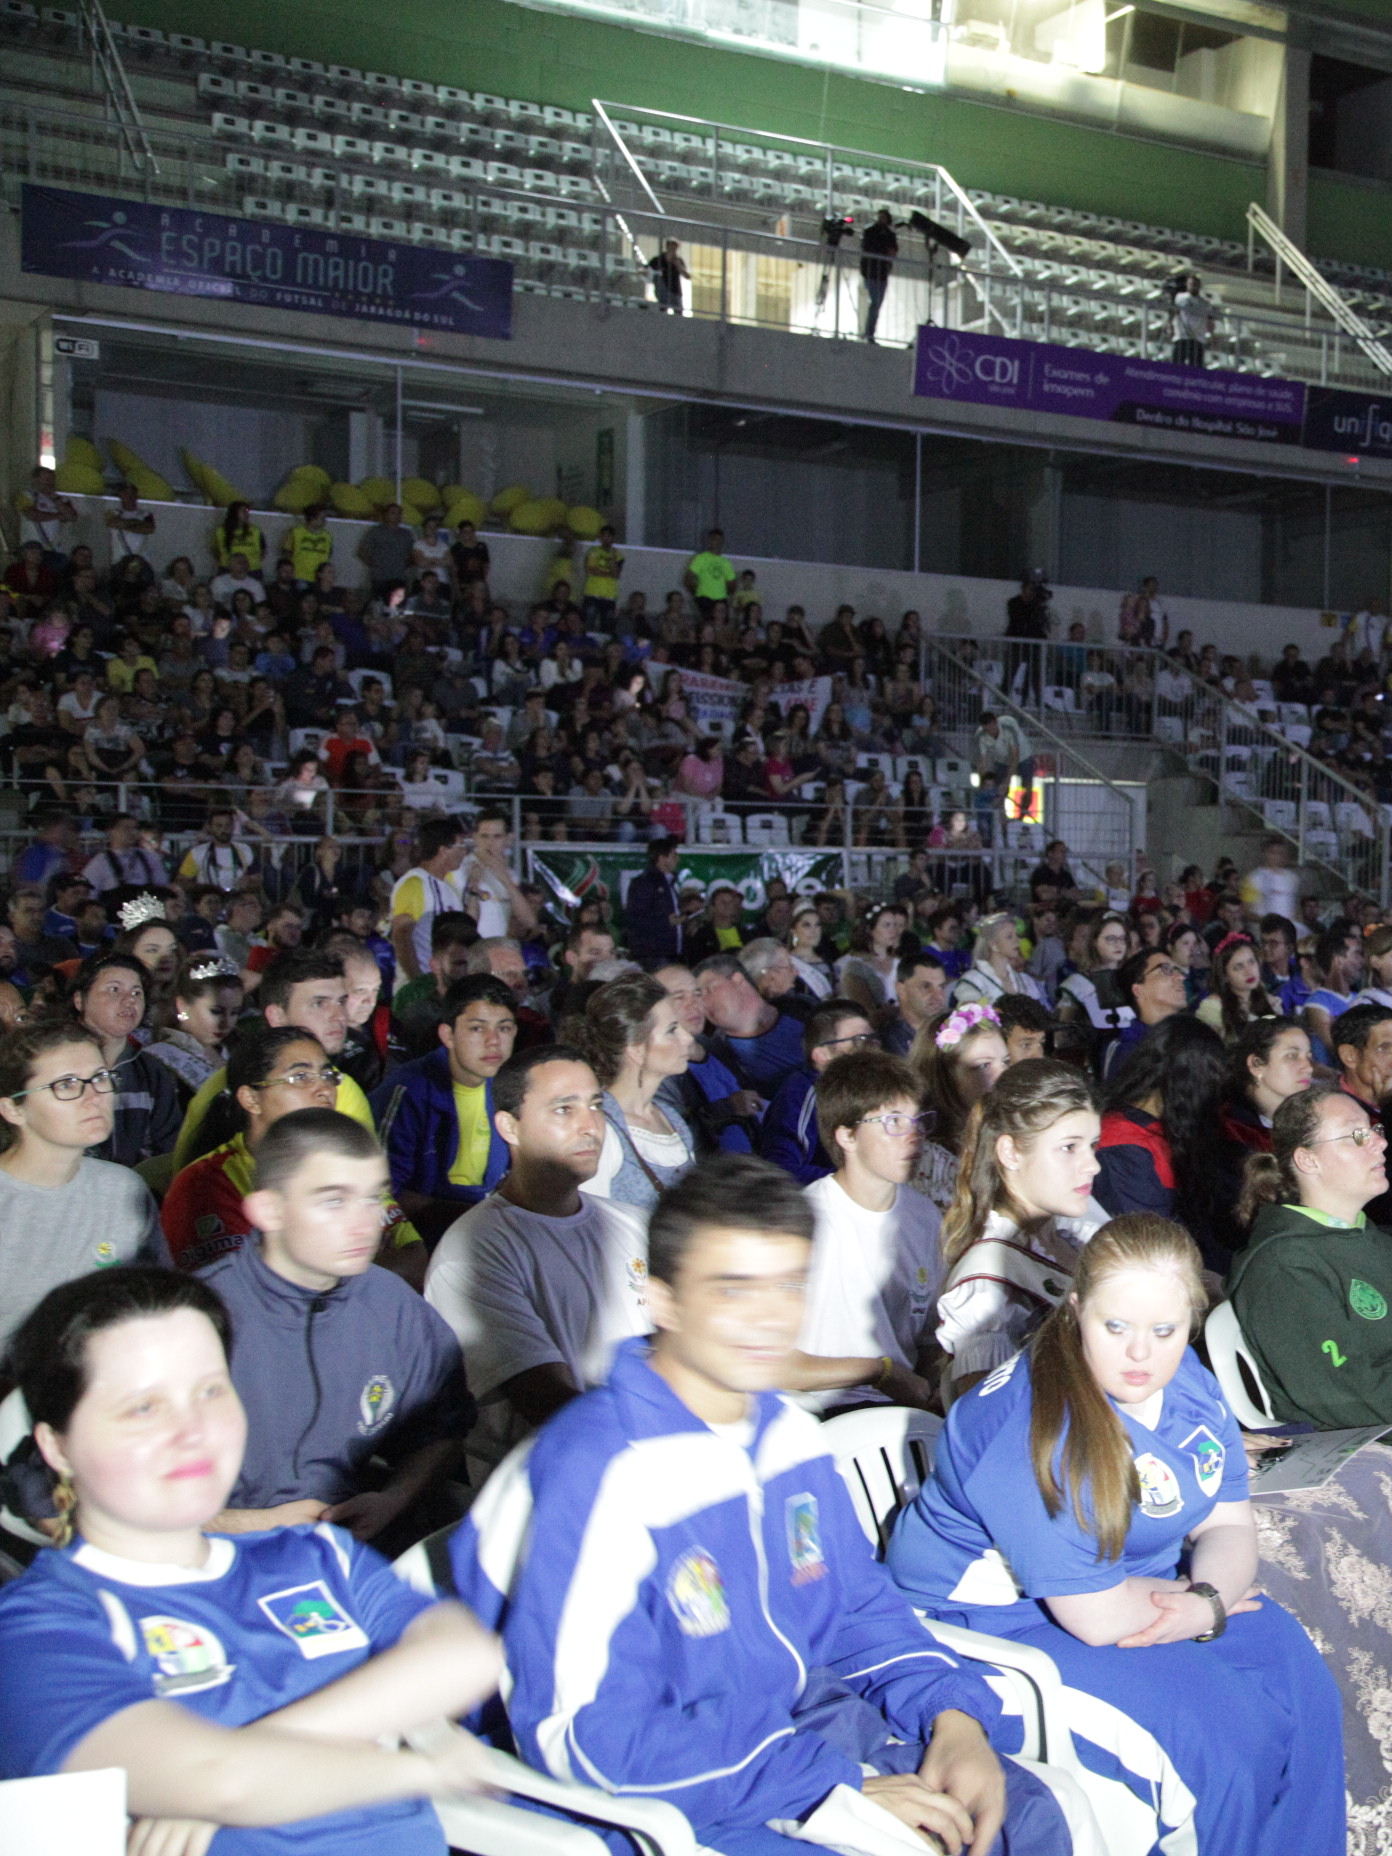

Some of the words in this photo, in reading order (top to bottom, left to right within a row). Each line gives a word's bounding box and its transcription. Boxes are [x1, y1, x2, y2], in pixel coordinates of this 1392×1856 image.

[160, 212, 397, 262] ACADEMIA
[160, 231, 284, 283] ESPAÇO
[296, 251, 395, 296] MAIOR
[276, 292, 324, 308] FUTSAL
[974, 354, 1020, 385] CDI
[1321, 1339, 1348, 1368] 2
